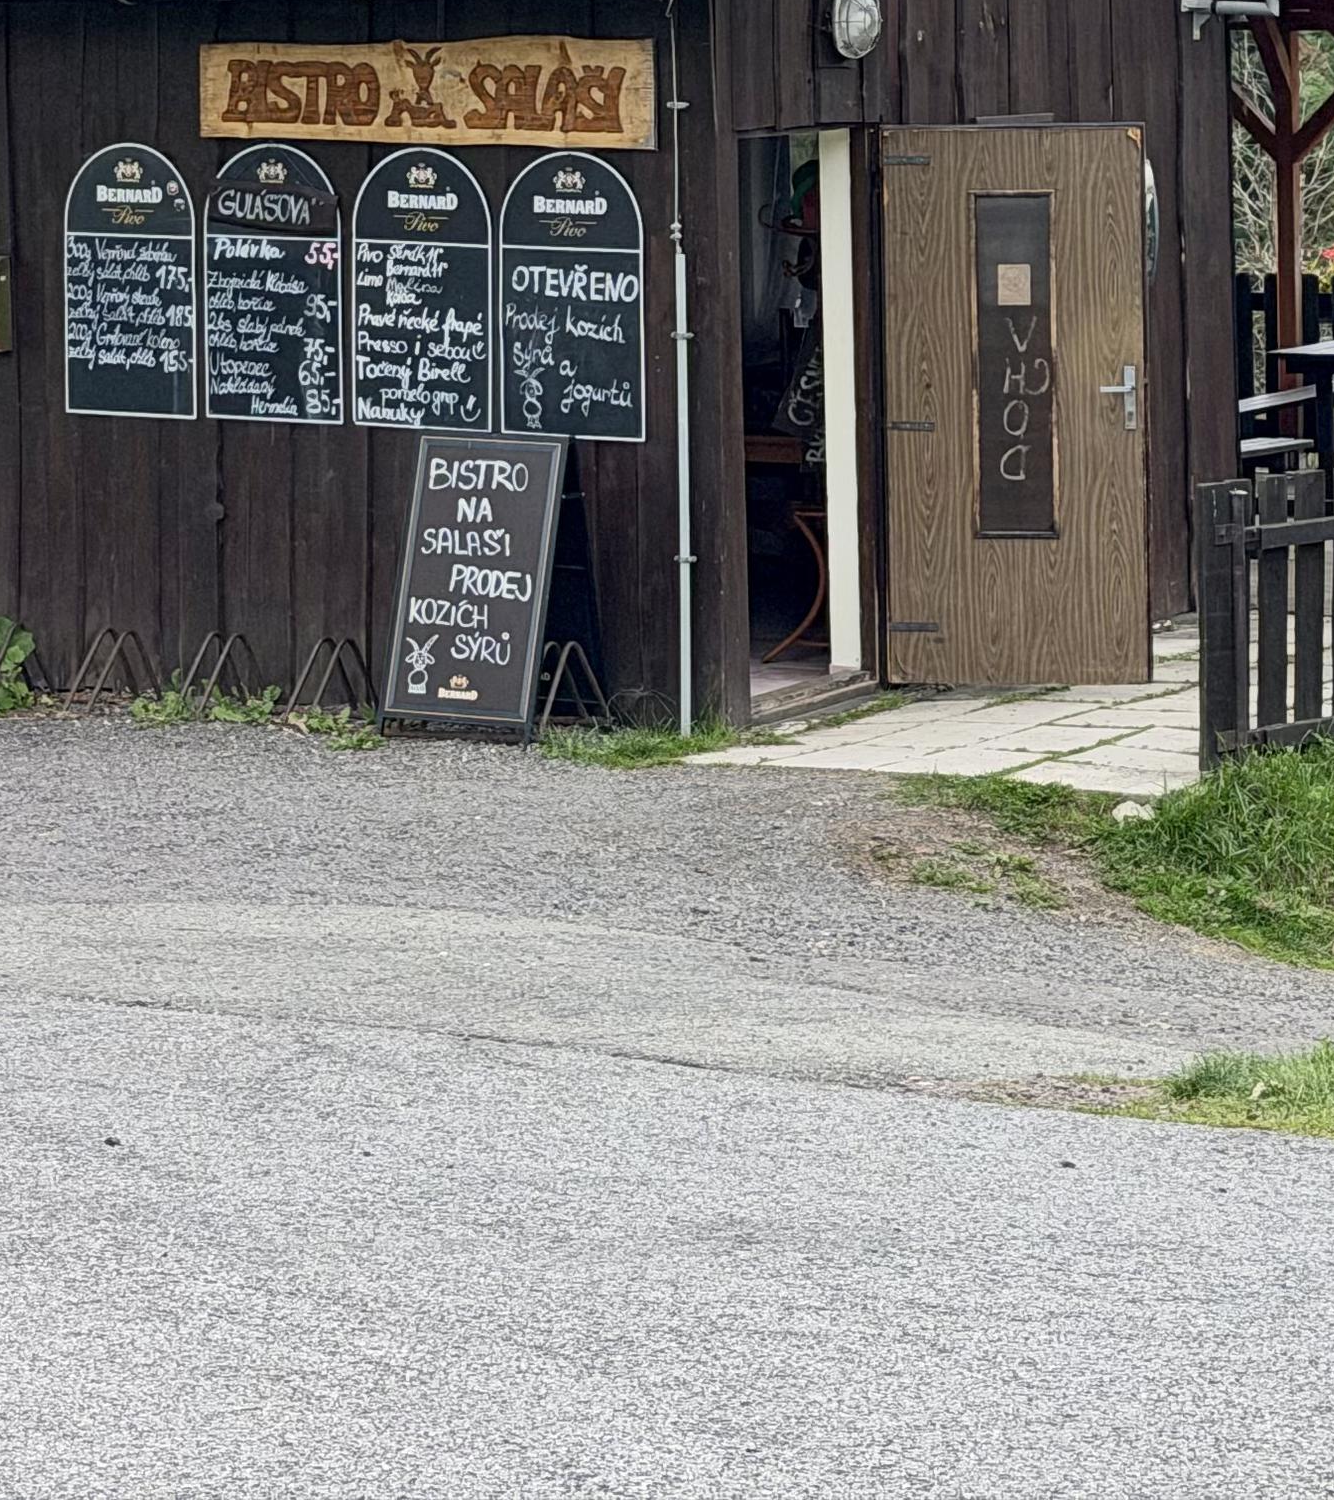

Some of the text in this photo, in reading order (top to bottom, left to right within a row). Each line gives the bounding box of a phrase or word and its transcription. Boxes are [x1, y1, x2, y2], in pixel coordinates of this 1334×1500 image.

[222, 59, 381, 126] BISTRO
[464, 63, 627, 133] SALAŠI
[96, 184, 163, 203] BERNARD
[387, 190, 459, 211] BERNARD
[533, 195, 607, 215] BERNARD
[112, 205, 145, 225] Pivo
[404, 211, 439, 232] Pivo
[550, 216, 586, 237] Pivo
[214, 237, 285, 260] Polévka
[357, 242, 383, 263] Pivo
[357, 268, 383, 287] Limo
[512, 264, 639, 302] OTEVŘENO
[505, 302, 561, 344] Prodej
[358, 331, 408, 354] Presso
[418, 357, 471, 383] Birell
[559, 360, 578, 377] a
[561, 379, 633, 417] jogurtů
[428, 457, 529, 491] BISTRO
[457, 497, 493, 523] NA
[421, 528, 510, 557] SALAŠI
[449, 564, 532, 601] PRODEJ
[409, 597, 488, 630] KOZÍCH
[451, 631, 511, 666] SÝRŮ
